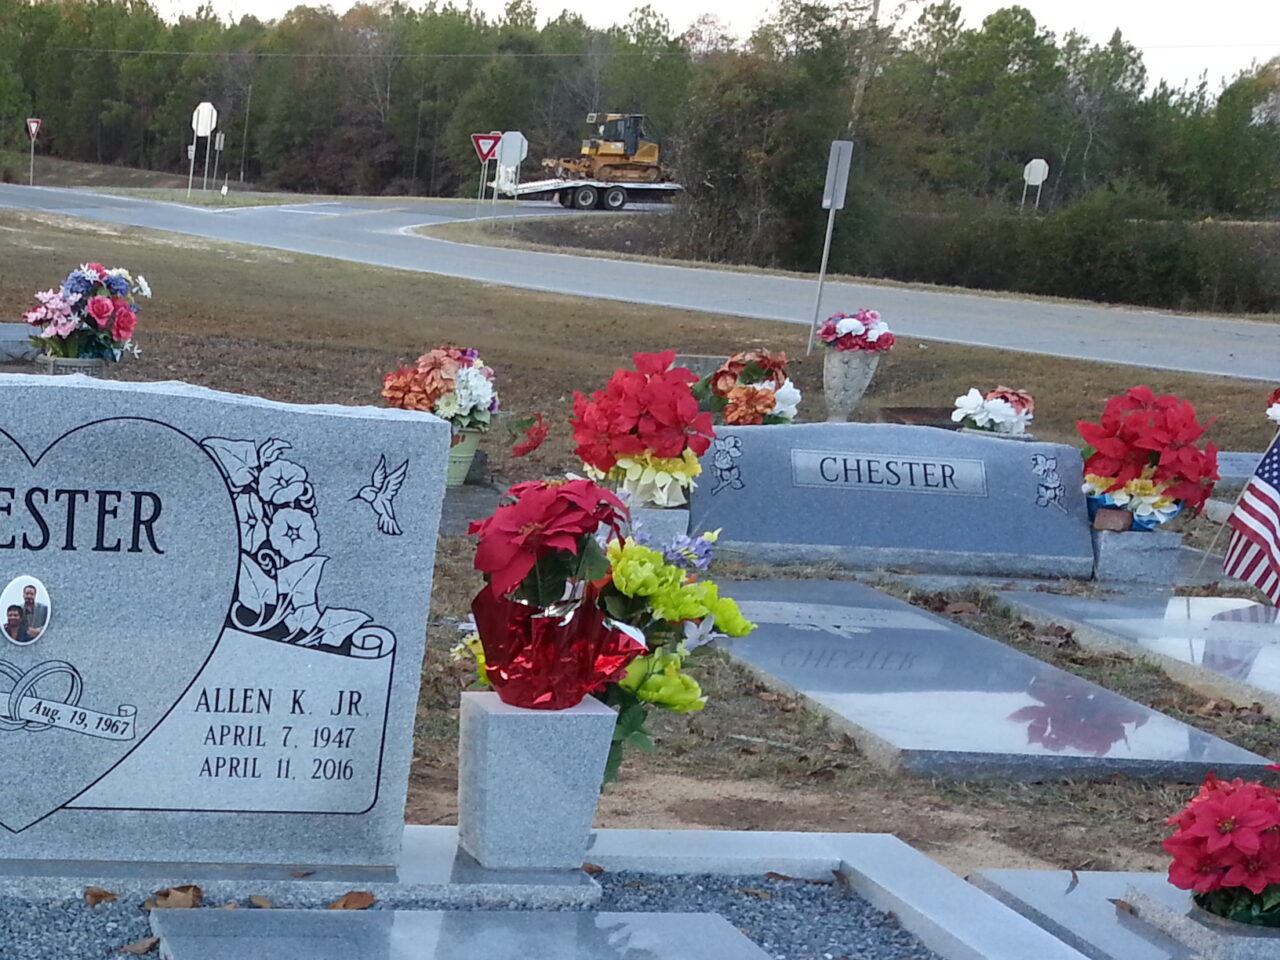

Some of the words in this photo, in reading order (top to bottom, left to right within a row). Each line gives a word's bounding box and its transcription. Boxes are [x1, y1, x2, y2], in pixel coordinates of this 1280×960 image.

[819, 456, 959, 490] CHESTER
[194, 687, 273, 715] ALLEN
[290, 689, 313, 715] K.
[28, 701, 62, 723] Aug.
[70, 710, 89, 730] 19,
[94, 716, 130, 737] 1967
[203, 725, 266, 747] APRIL
[312, 726, 356, 749] 1947
[199, 756, 262, 779] APRIL
[311, 758, 354, 781] 2016
